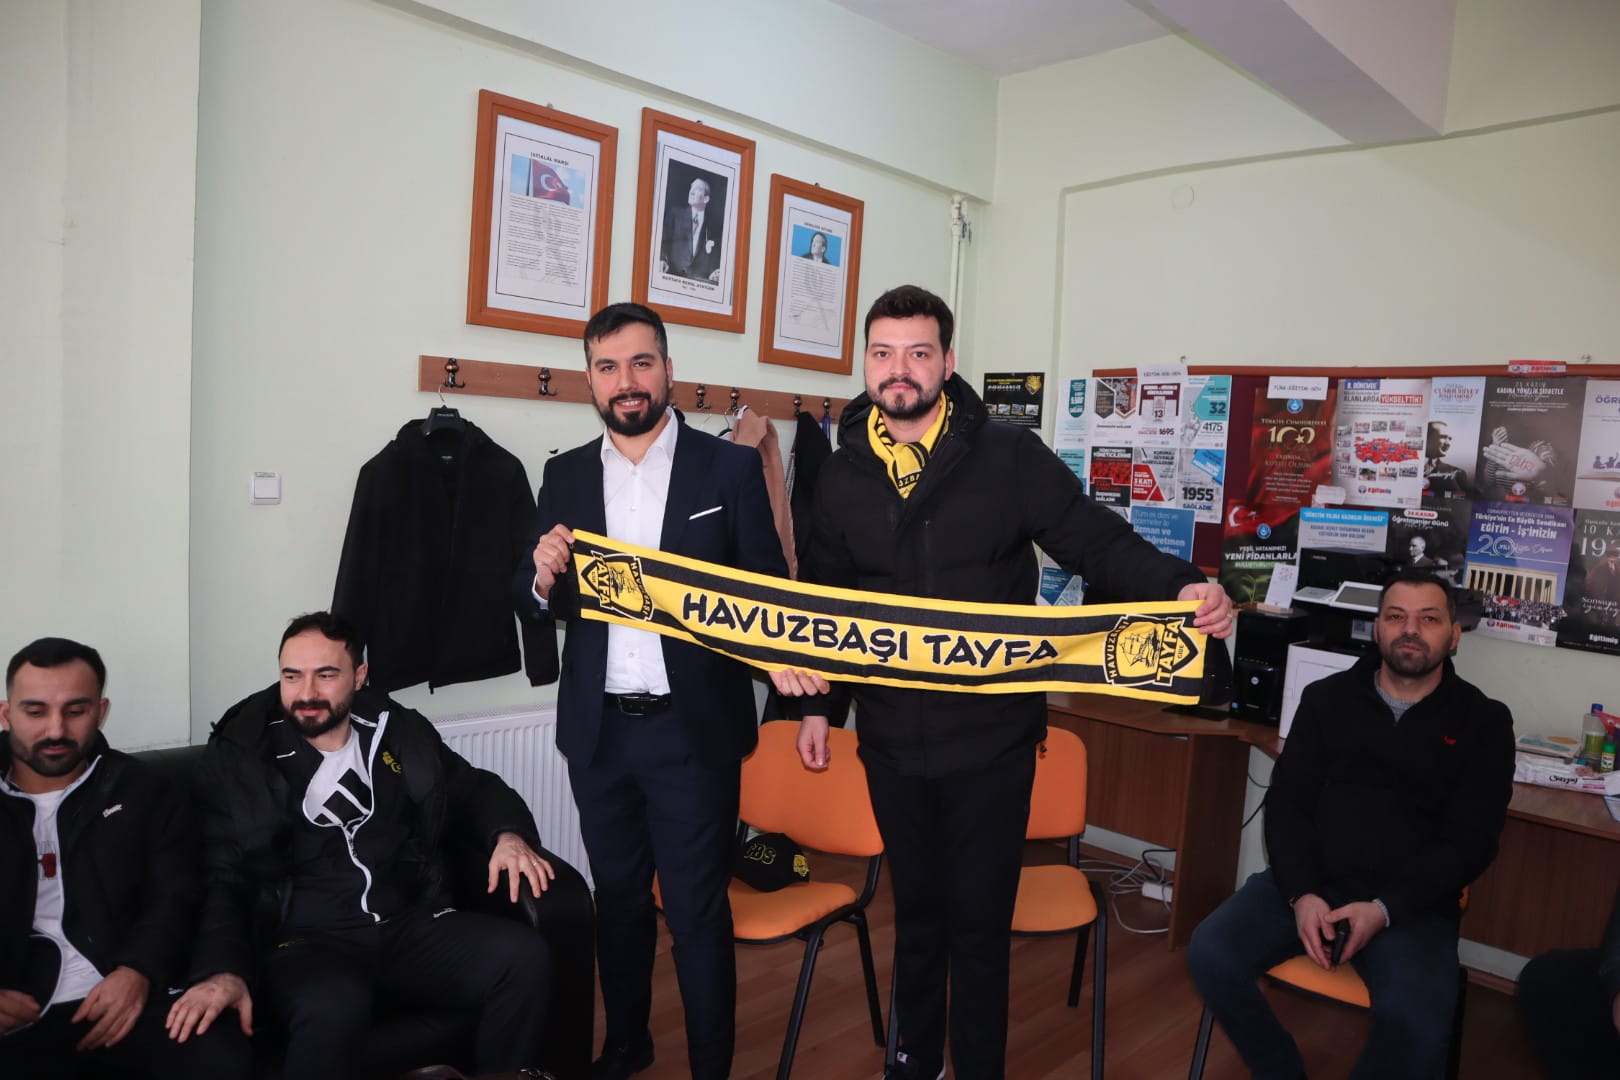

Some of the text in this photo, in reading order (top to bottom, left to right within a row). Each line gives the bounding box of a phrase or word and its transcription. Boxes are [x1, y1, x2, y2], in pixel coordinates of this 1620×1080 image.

[1154, 410, 1163, 418] 13
[1209, 402, 1226, 414] 32
[1202, 422, 1223, 432] 4175
[1182, 487, 1214, 501] 1955
[1480, 522, 1510, 534] EĞİTİM
[1225, 552, 1297, 560] YENİ FİDANLARLA
[683, 592, 1059, 668] HAVUZBAŞI TAYFA
[1157, 620, 1183, 681] TAYFA
